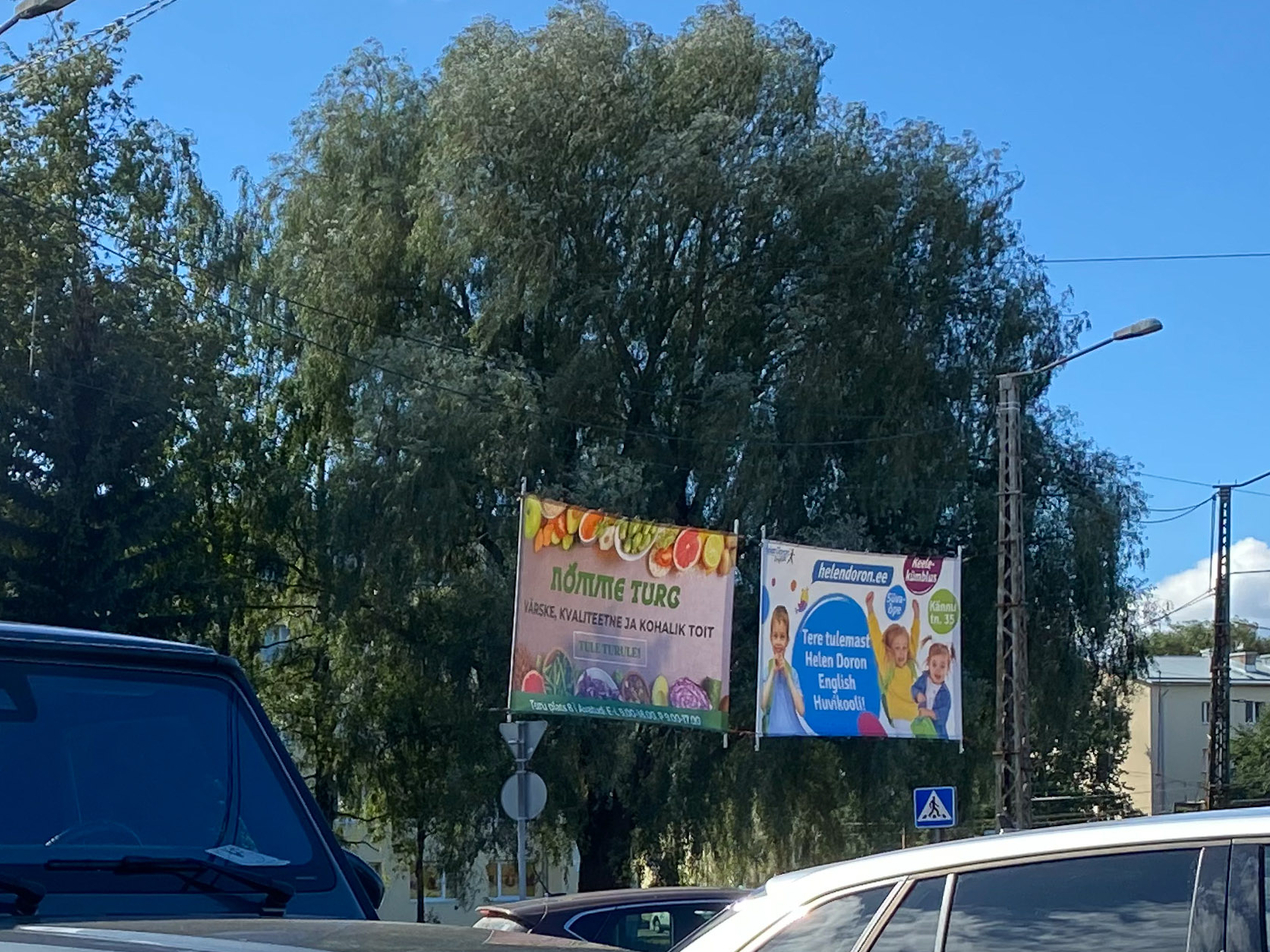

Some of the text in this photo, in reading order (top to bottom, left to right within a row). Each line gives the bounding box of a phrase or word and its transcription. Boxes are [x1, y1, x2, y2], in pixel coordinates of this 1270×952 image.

[817, 561, 888, 584] helendoron.ee
[631, 580, 681, 609] TURG
[523, 598, 714, 638] VÄRSKE, KVALITEETNE JA KOHALIK TOIT
[943, 614, 955, 625] 35
[578, 640, 601, 654] TULE
[802, 629, 870, 648] Tere tulemast
[805, 651, 867, 669] Helen Doron
[818, 673, 856, 693] English
[813, 694, 866, 711] Huvikooli!
